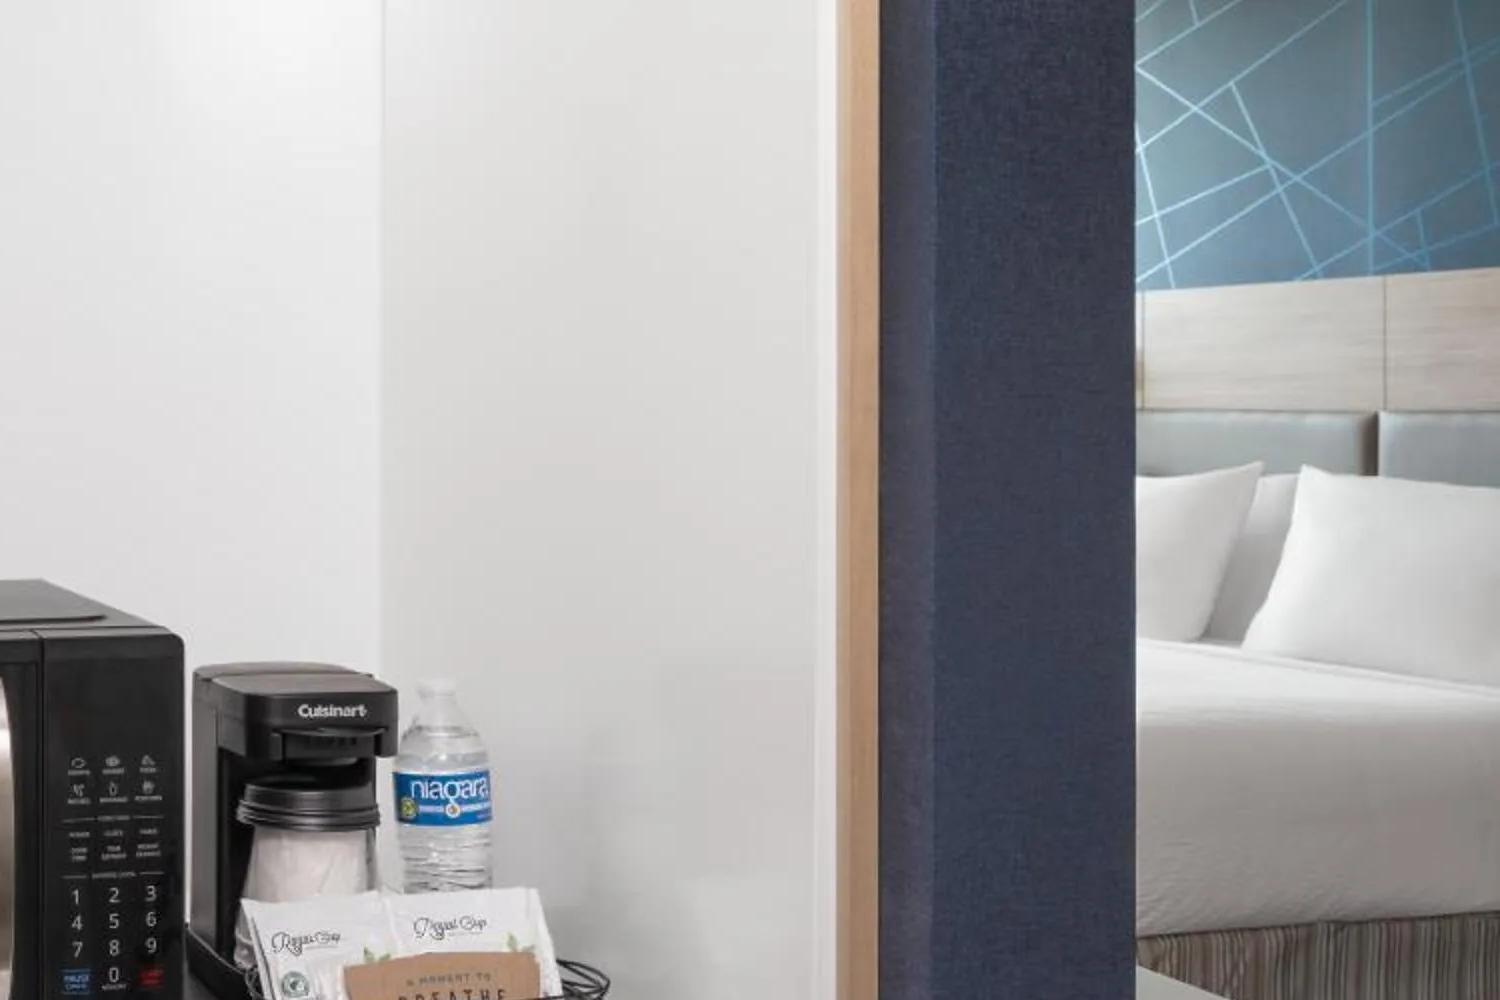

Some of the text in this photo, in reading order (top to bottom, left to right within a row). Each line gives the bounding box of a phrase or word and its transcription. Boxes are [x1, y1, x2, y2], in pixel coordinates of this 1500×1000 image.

[297, 703, 366, 718] Cuisinart
[410, 777, 489, 806] niagara
[71, 888, 80, 905] 1
[108, 887, 121, 903] 2
[145, 885, 157, 902] 3
[71, 914, 83, 931] 4
[108, 913, 120, 929] 5
[145, 911, 157, 927] 6
[71, 941, 83, 958] 7
[108, 939, 121, 956] 8
[145, 937, 157, 953] 9
[108, 966, 120, 982] 0
[418, 972, 472, 986] MOMENT
[476, 972, 492, 982] TO
